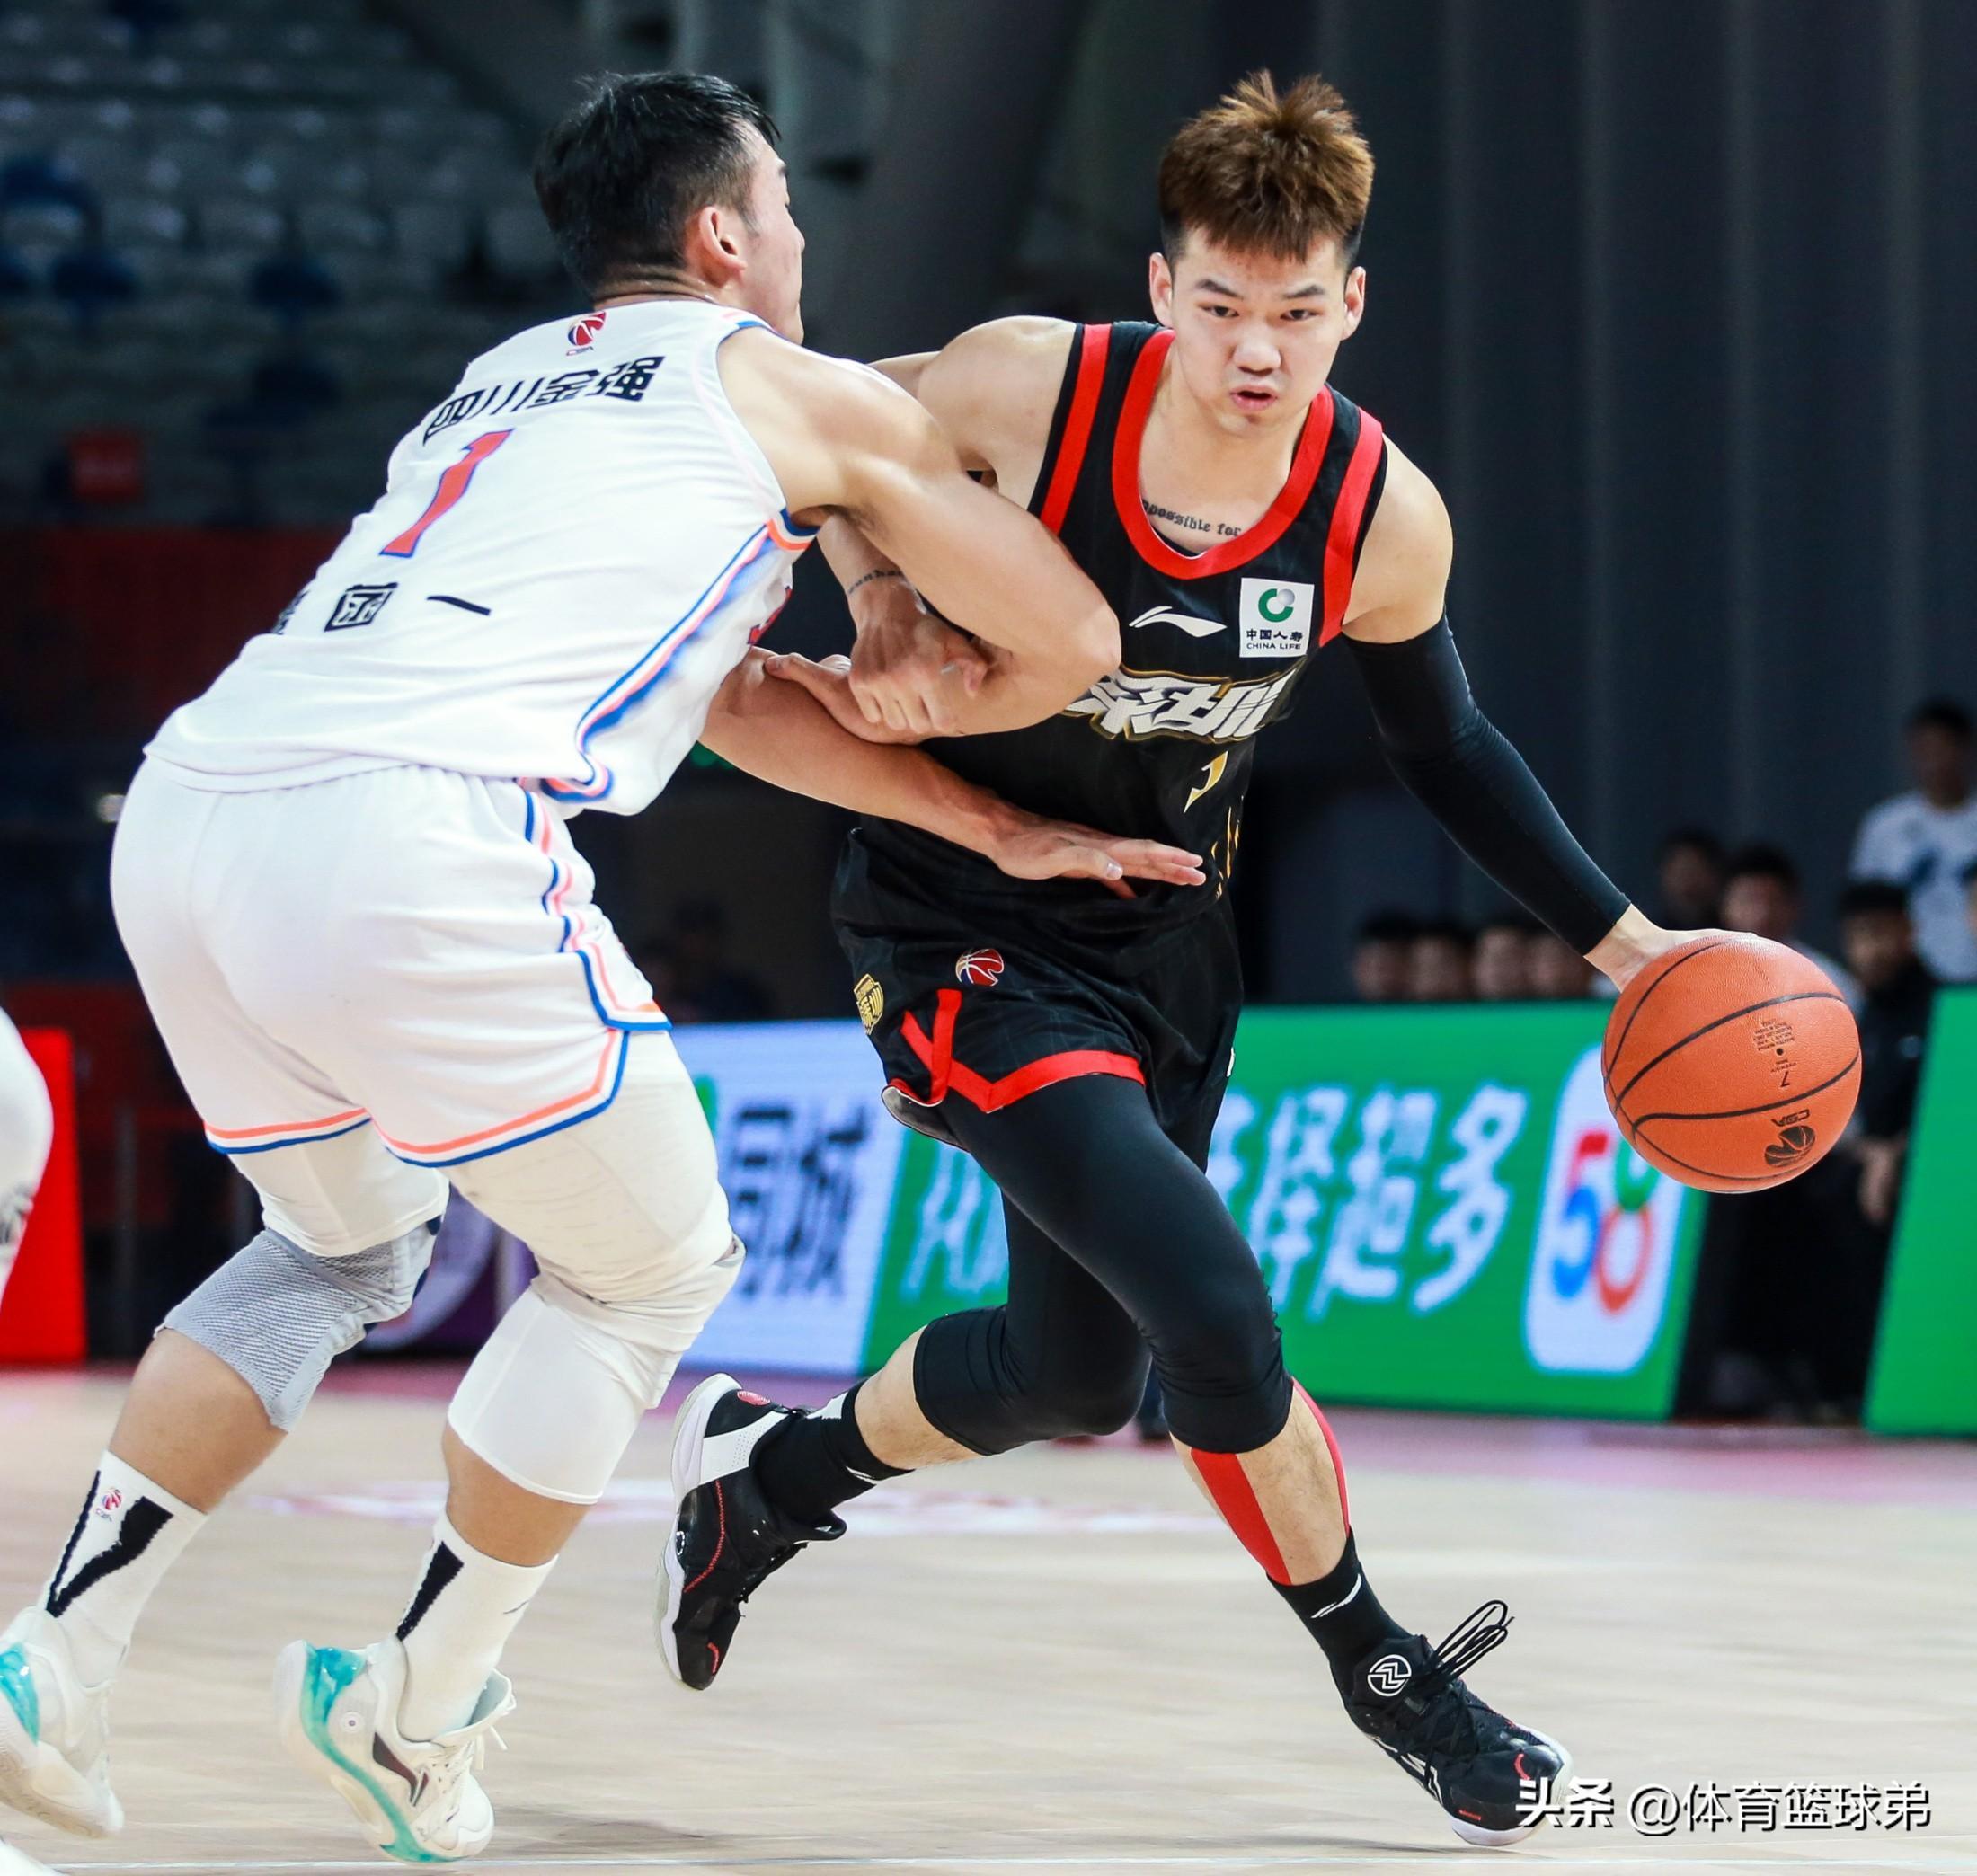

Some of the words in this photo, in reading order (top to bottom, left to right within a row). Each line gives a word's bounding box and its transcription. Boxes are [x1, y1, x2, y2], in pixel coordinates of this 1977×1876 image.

[422, 356, 665, 447] 四川金强
[378, 428, 515, 558] 1
[1246, 628, 1304, 642] 中国人寿
[1246, 642, 1276, 650] CHINA
[1280, 642, 1302, 650] LIFE
[1780, 1071, 1791, 1088] 7
[1551, 1128, 1662, 1315] 58
